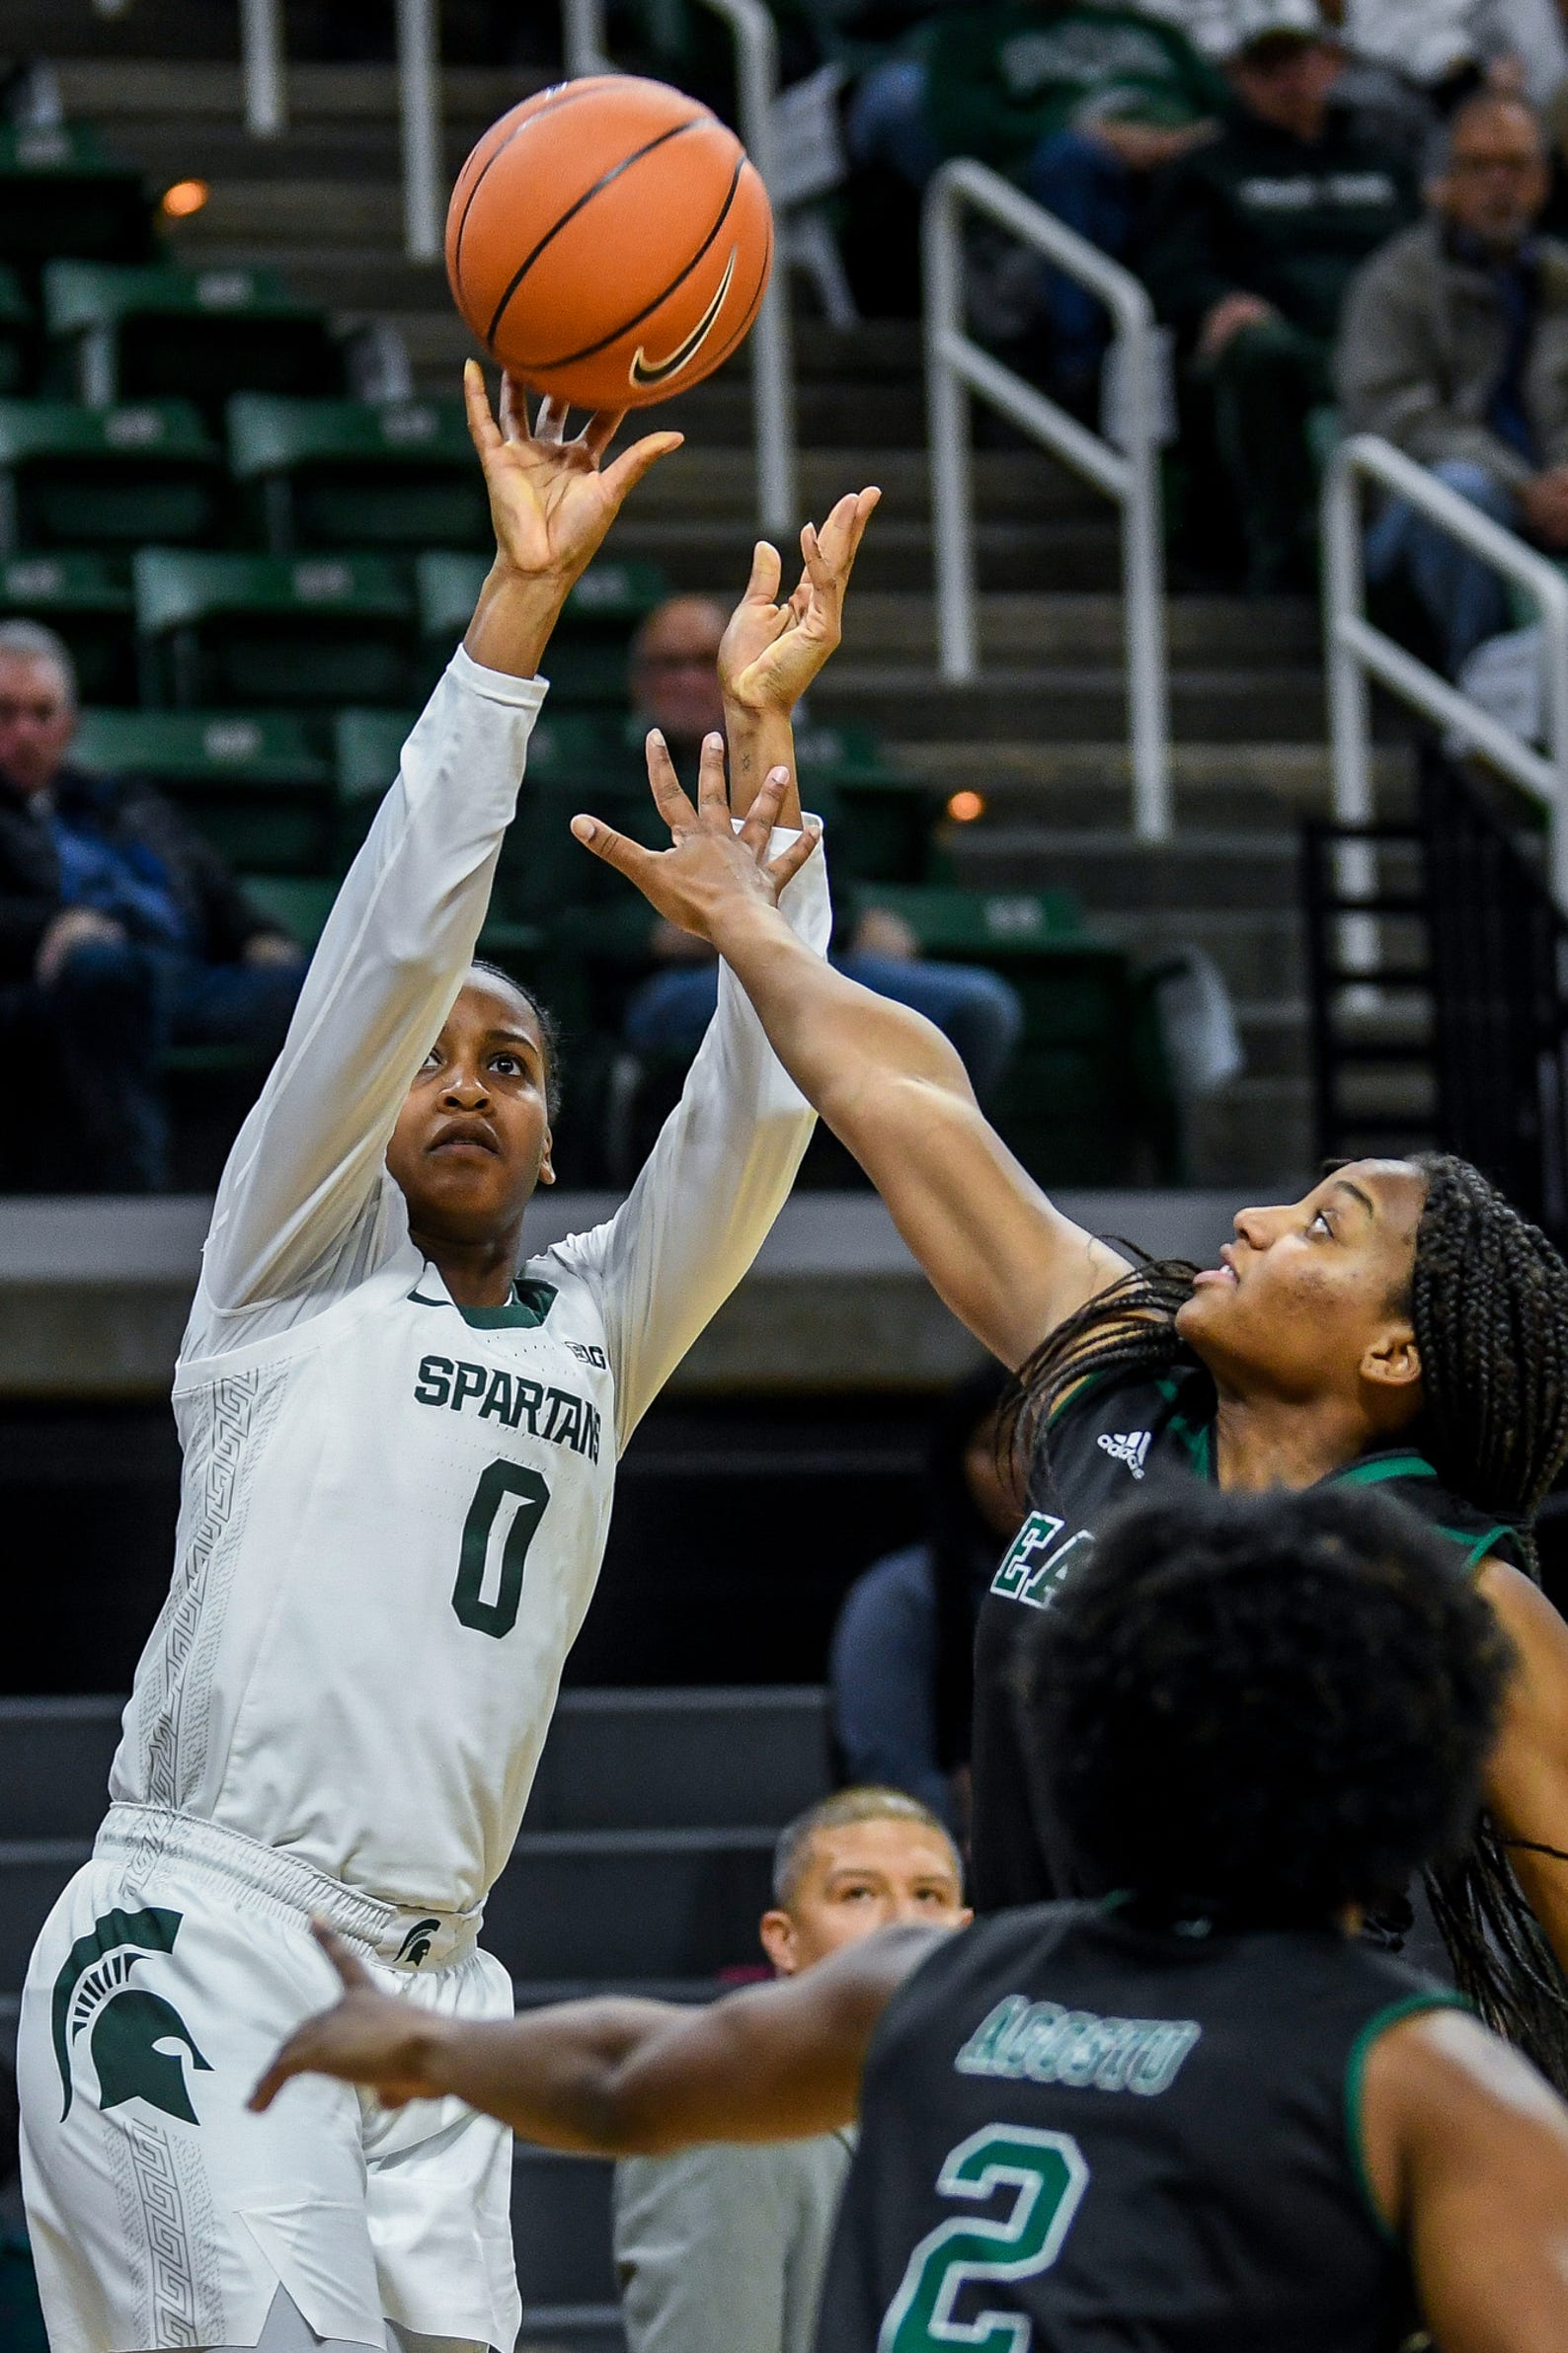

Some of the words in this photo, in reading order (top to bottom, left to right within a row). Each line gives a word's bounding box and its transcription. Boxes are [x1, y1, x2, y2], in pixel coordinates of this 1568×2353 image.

[414, 1355, 601, 1466] SPARTANS
[451, 1457, 551, 1639] 0
[877, 2123, 1089, 2353] 2
